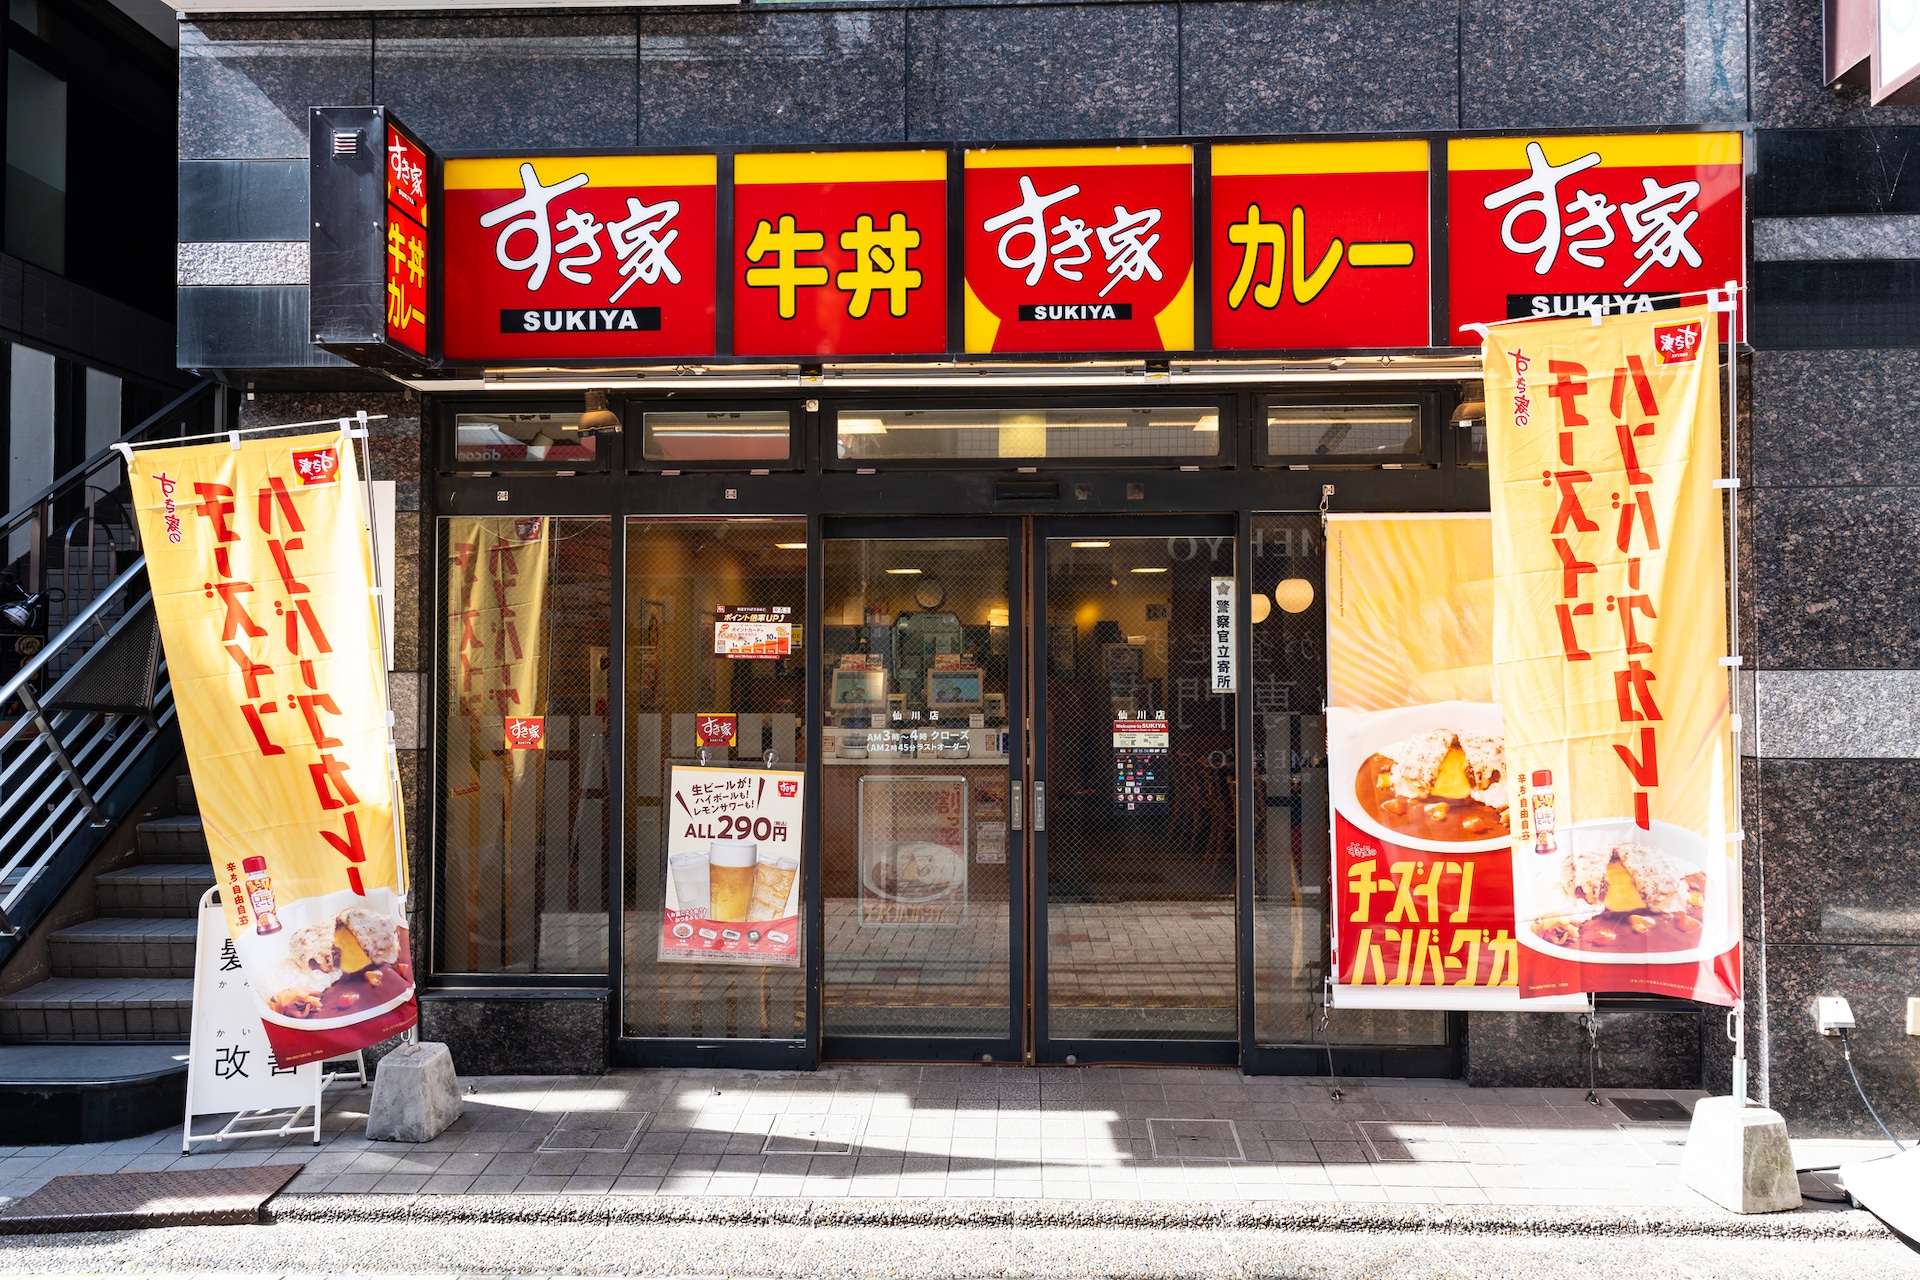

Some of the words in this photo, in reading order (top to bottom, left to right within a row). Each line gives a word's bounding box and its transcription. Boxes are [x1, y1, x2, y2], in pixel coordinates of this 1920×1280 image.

[388, 135, 423, 197] すき家
[1483, 141, 1705, 288] すき家
[480, 163, 682, 304] すき家
[983, 174, 1163, 297] すき家
[387, 221, 426, 289] 牛丼
[744, 212, 922, 319] 牛丼
[1227, 202, 1415, 311] カレー
[387, 280, 426, 332] カレー
[1034, 305, 1117, 320] SUKIYA
[1530, 294, 1655, 317] SUKIYA
[523, 310, 638, 331] SUKIYA
[724, 613, 779, 622] ポイント倍率UP
[1216, 600, 1231, 688] 警察官立寄所
[892, 710, 939, 720] 仙川店
[1118, 710, 1166, 720] 仙川店
[509, 719, 540, 741] すき家
[701, 716, 732, 738] すき家
[930, 730, 970, 740] クローズ
[691, 777, 752, 796] 生ビールが!
[695, 790, 749, 805] ハイボールも!
[693, 800, 754, 816] レモンサワーも!
[684, 823, 716, 839] ALL
[1347, 859, 1475, 923] チーズイン
[1350, 929, 1519, 987] ハンバーグカ
